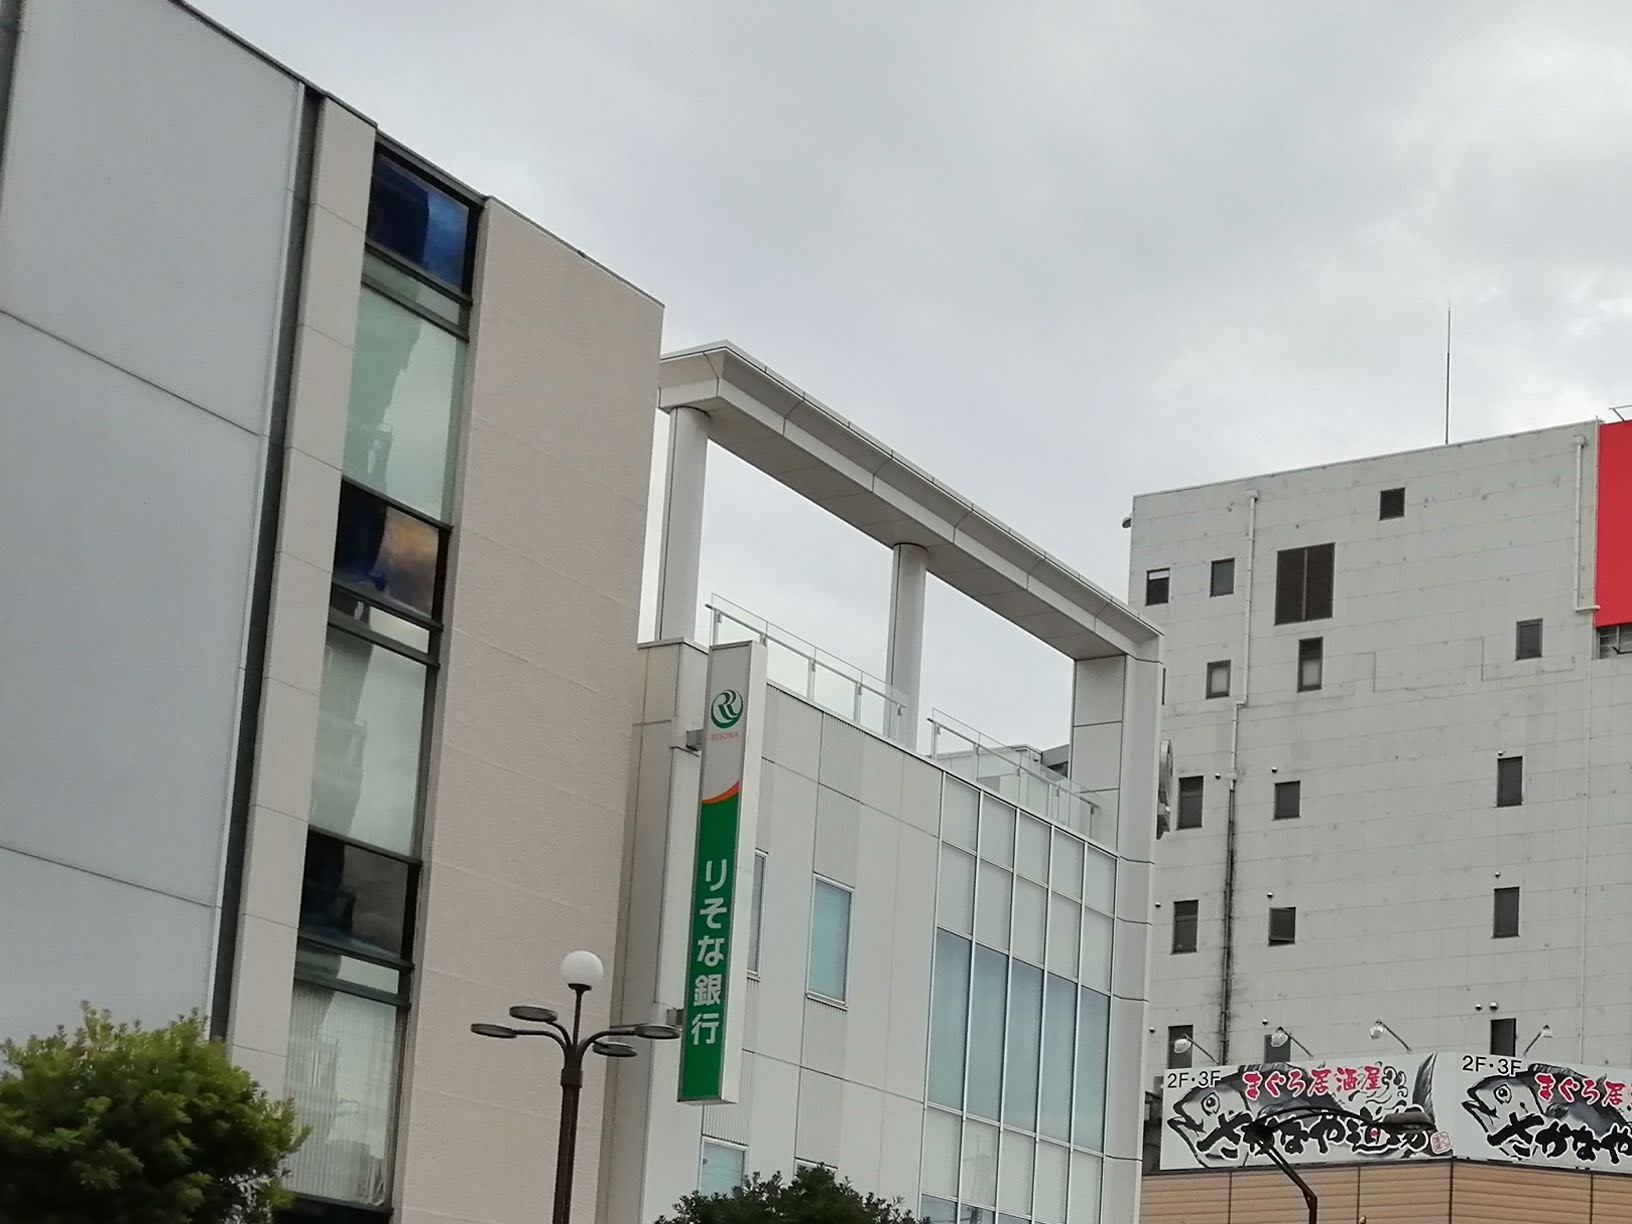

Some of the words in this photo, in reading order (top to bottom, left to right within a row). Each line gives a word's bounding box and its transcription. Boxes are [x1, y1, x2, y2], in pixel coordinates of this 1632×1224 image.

[691, 859, 728, 1047] りそな銀行
[1242, 1065, 1382, 1099] まぐろ居酒屋
